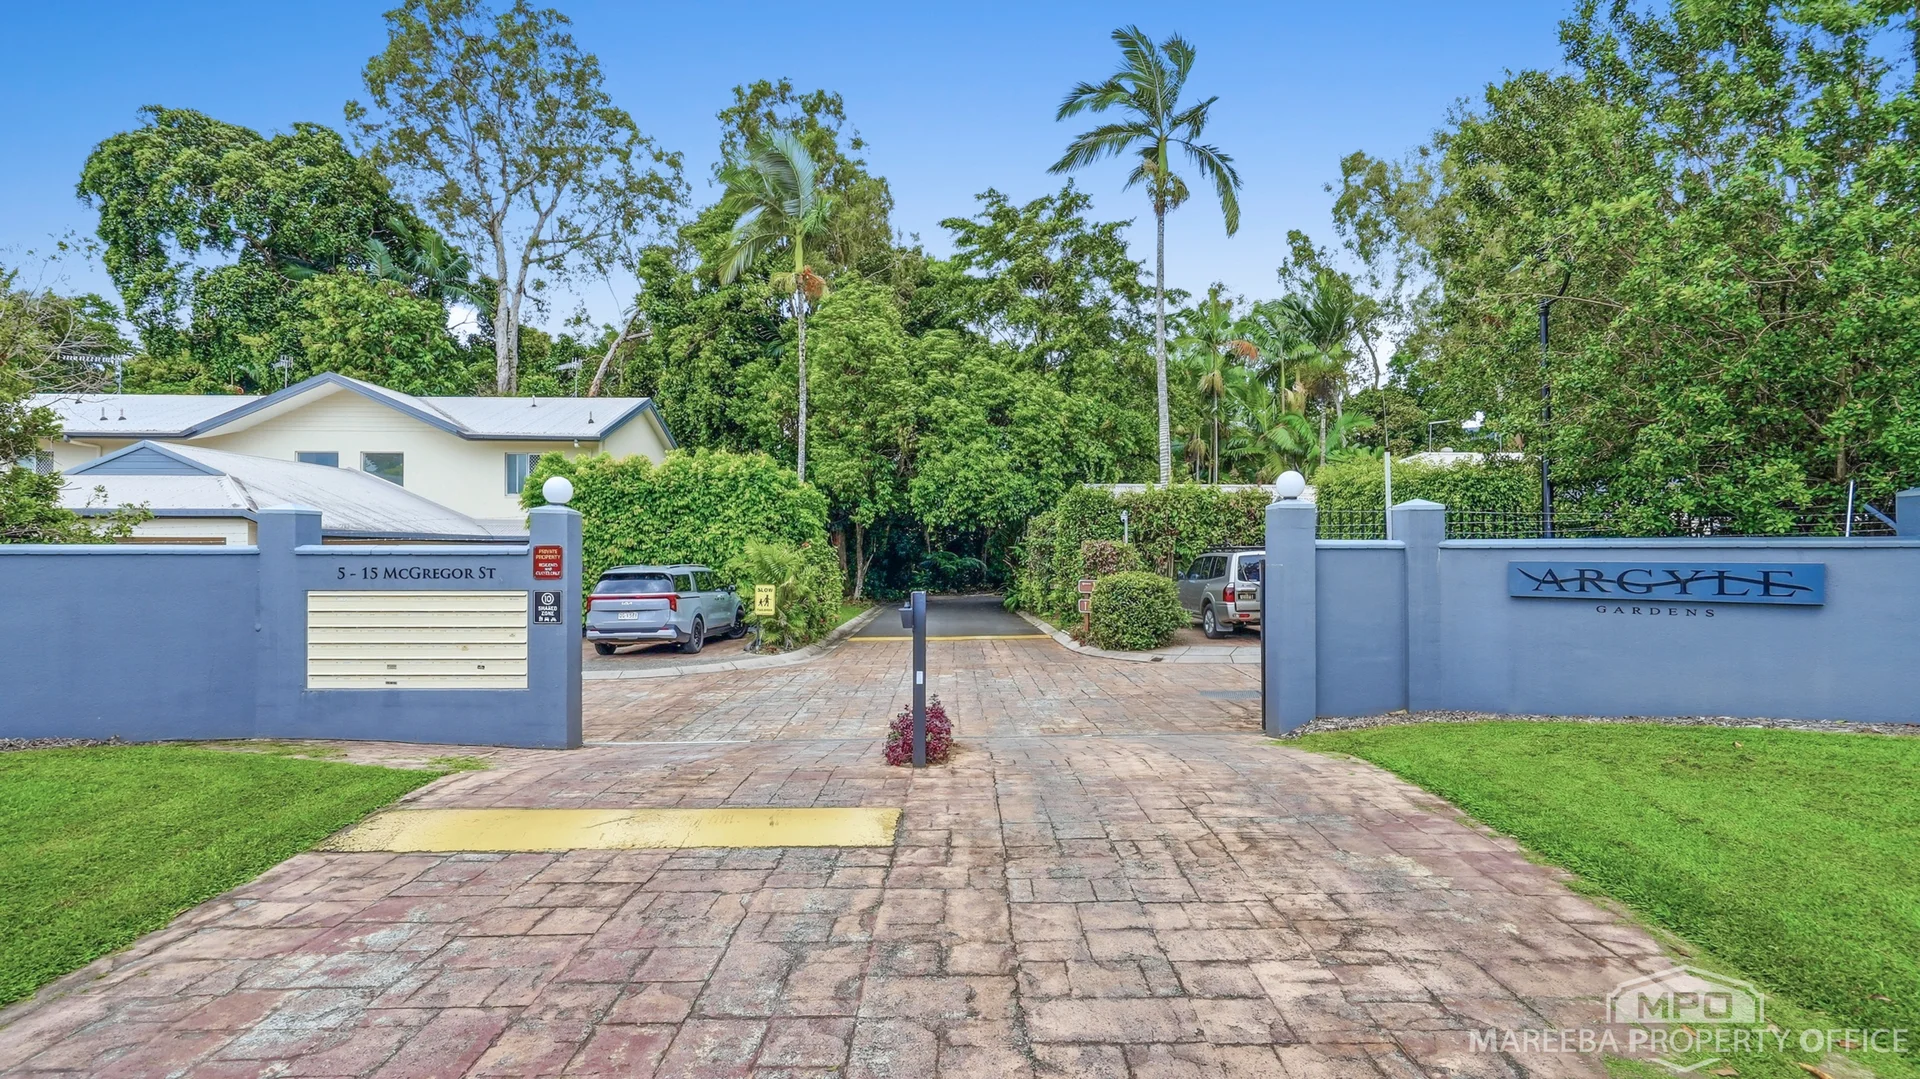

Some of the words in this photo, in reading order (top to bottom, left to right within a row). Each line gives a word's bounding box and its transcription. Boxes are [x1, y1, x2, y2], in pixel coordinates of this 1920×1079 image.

[337, 567, 346, 580] 5
[362, 566, 378, 580] 15
[1532, 567, 1797, 597] ARGYLE
[544, 595, 552, 603] 10
[1596, 605, 1715, 618] GARDENS
